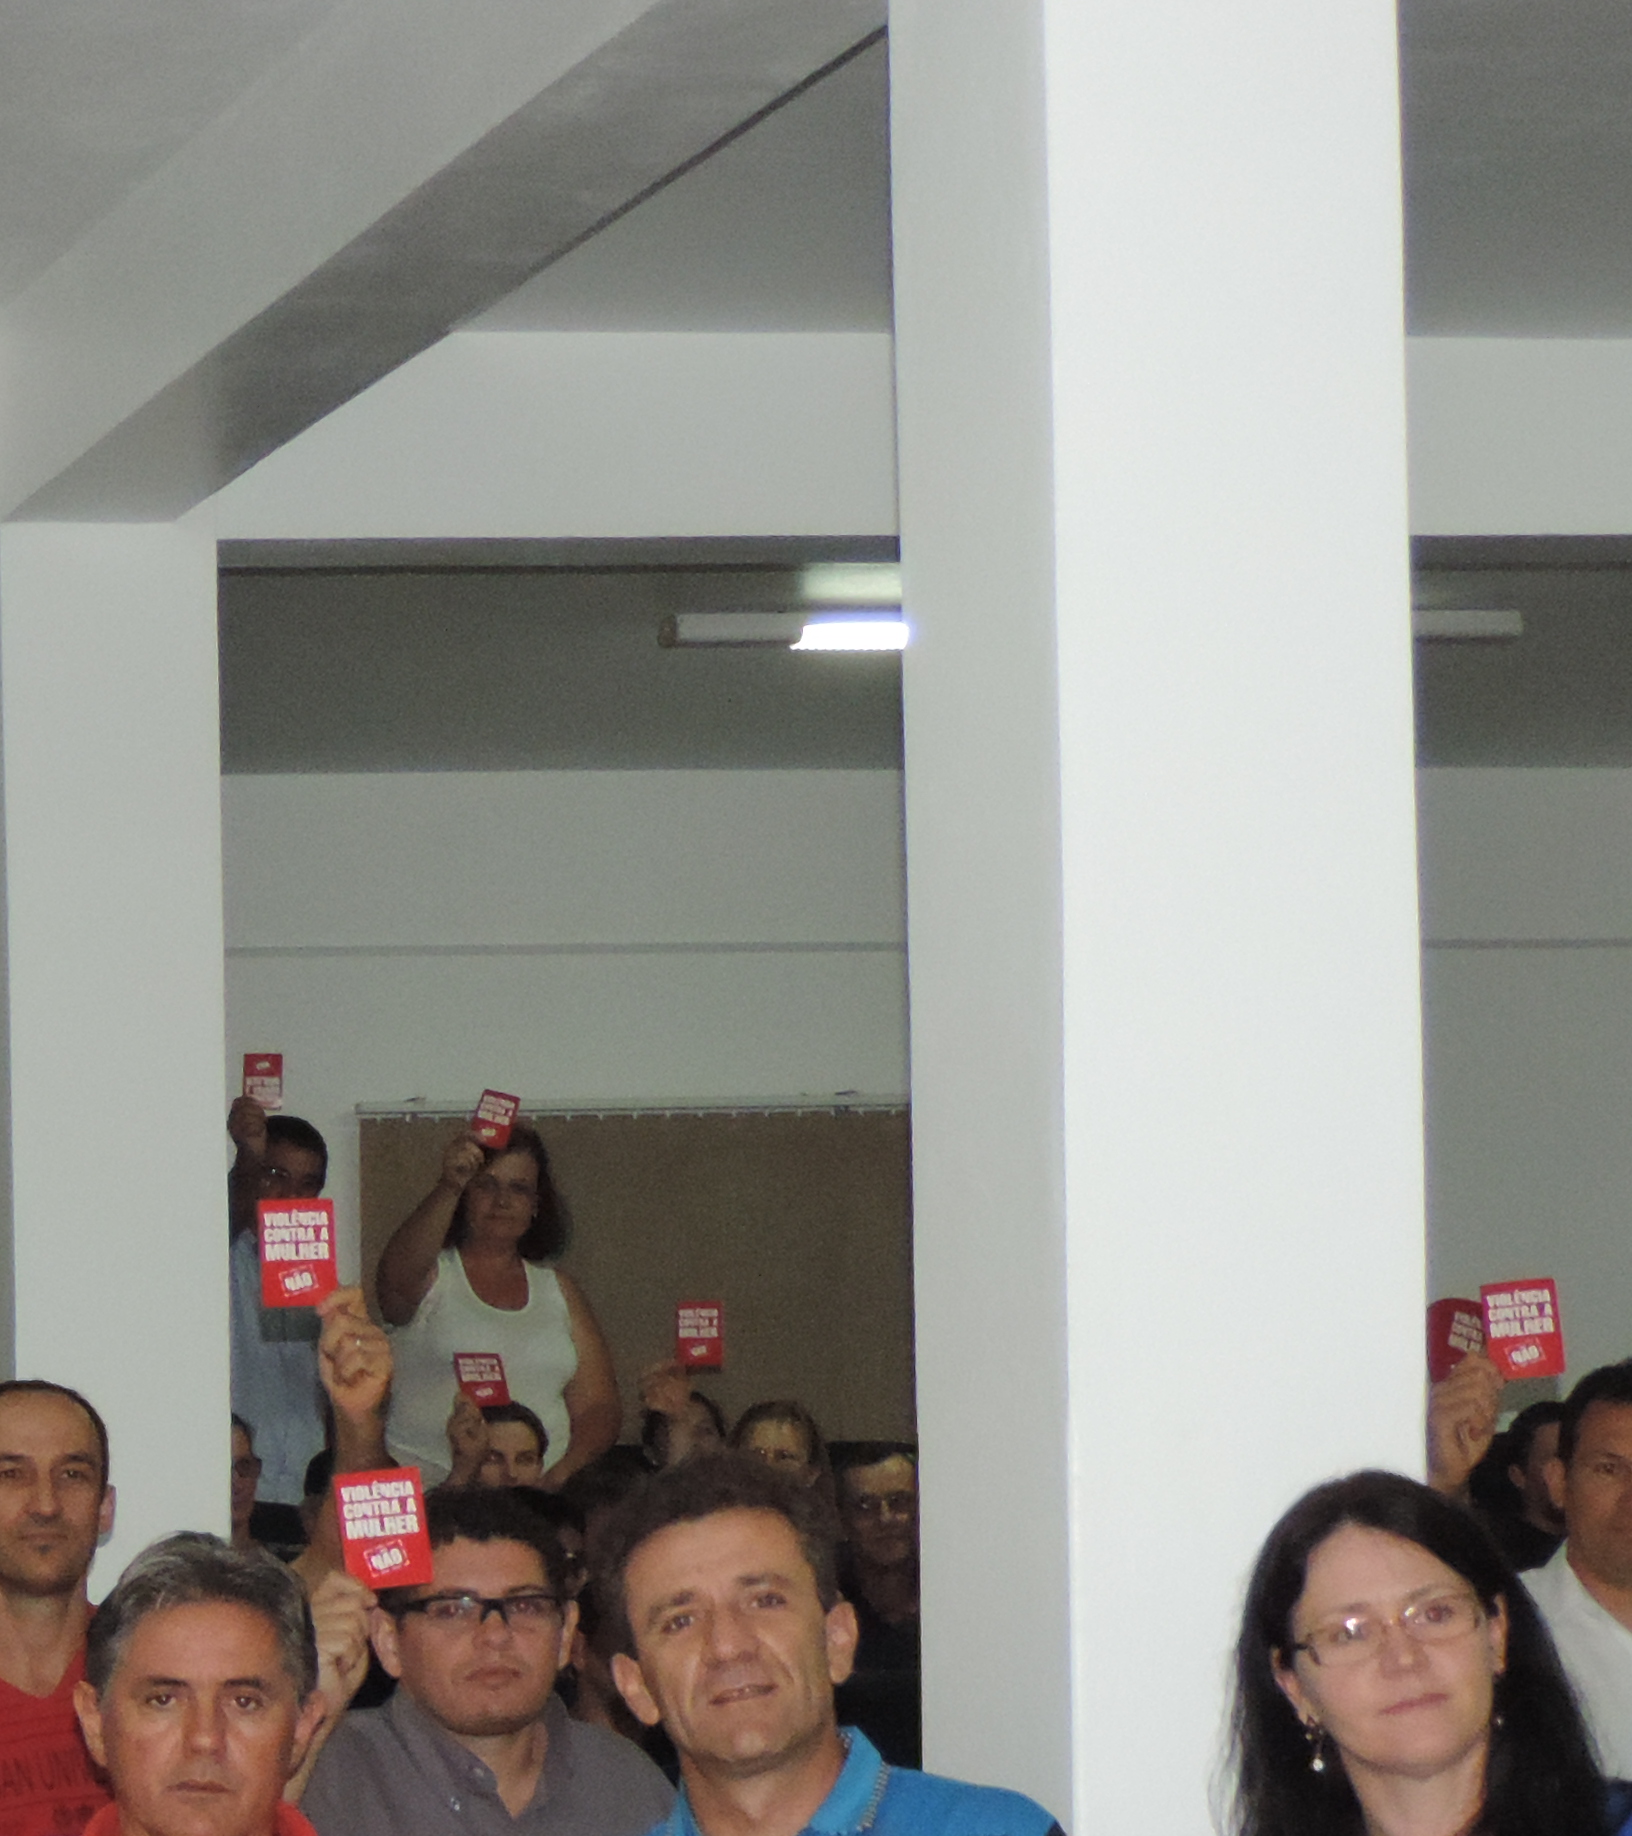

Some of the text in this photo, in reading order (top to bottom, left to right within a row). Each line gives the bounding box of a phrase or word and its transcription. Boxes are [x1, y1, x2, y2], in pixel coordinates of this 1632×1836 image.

[264, 1210, 327, 1226] VIOLÊNCIA
[264, 1226, 314, 1242] CONTRA
[265, 1241, 328, 1260] MULHER
[1487, 1289, 1550, 1307] VIOLÊNCIA
[1488, 1303, 1538, 1321] CONTRA
[1490, 1316, 1553, 1337] MULHER
[341, 1481, 413, 1502] VIOLÊNCIA
[343, 1497, 400, 1518] CONTRA
[346, 1512, 418, 1538] MULHER
